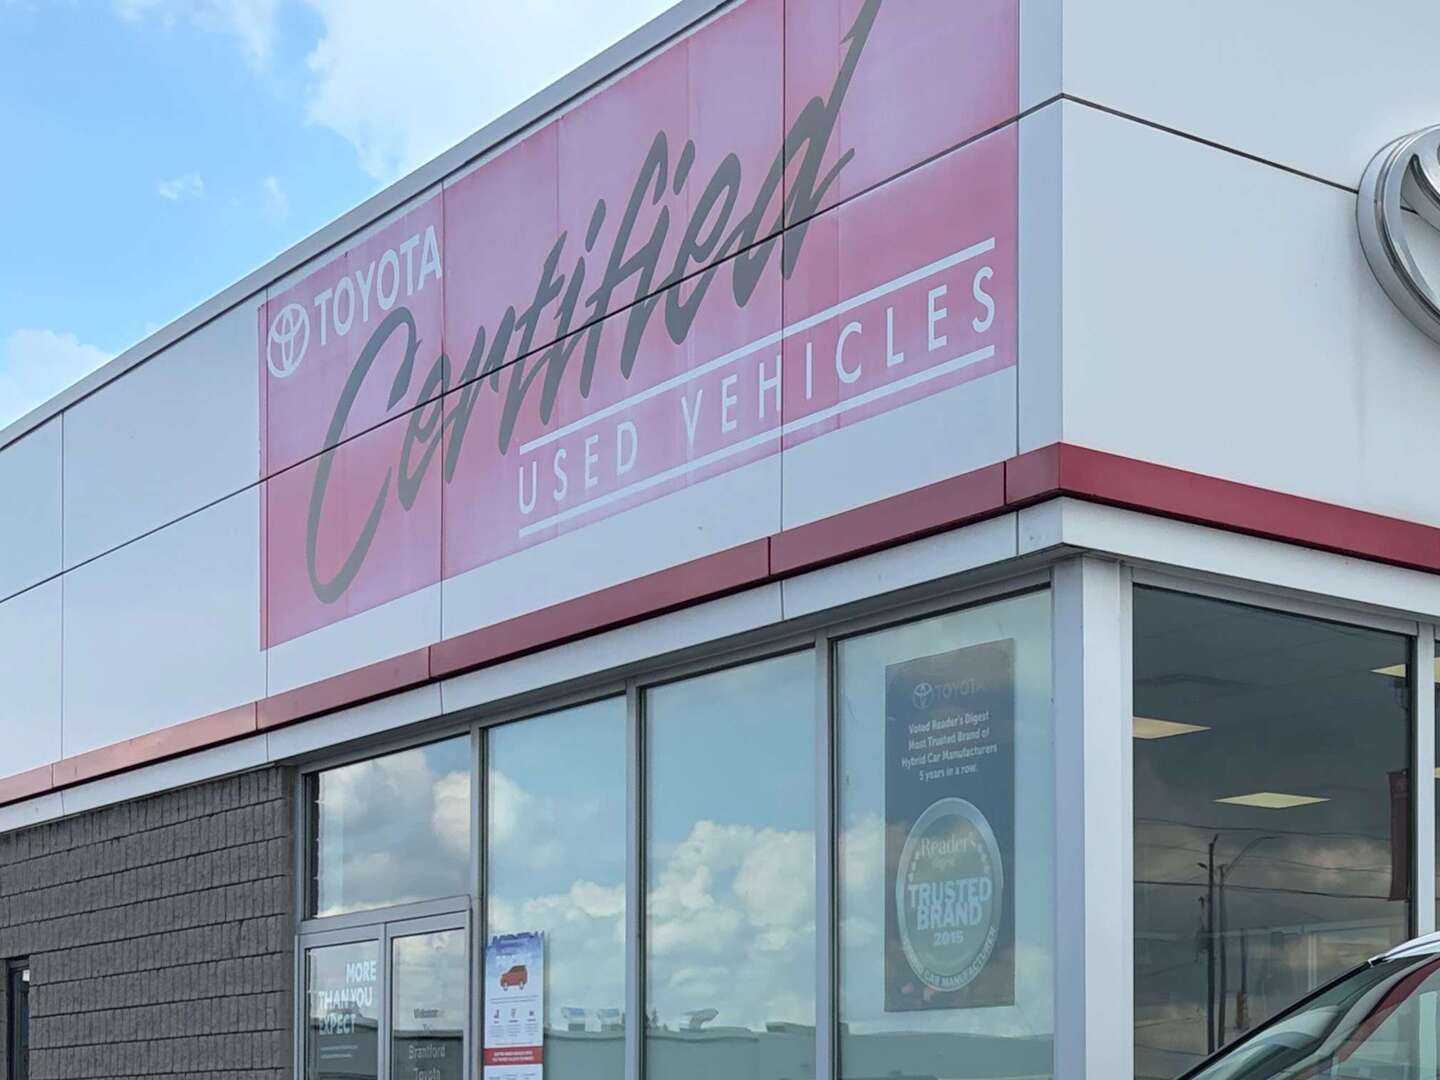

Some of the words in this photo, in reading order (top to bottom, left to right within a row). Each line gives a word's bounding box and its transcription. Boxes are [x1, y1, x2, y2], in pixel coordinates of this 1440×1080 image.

[314, 225, 442, 346] TOYOTA
[306, 0, 881, 603] Certified
[519, 421, 638, 514] USED
[681, 266, 995, 448] VEHICLES
[908, 877, 992, 908] TRUSTED
[916, 900, 983, 930] BRAND
[934, 930, 964, 946] 2015
[346, 960, 377, 983] MORE
[319, 988, 349, 1009] THAN
[350, 986, 372, 1008] YOU
[320, 1013, 356, 1035] EXPECT
